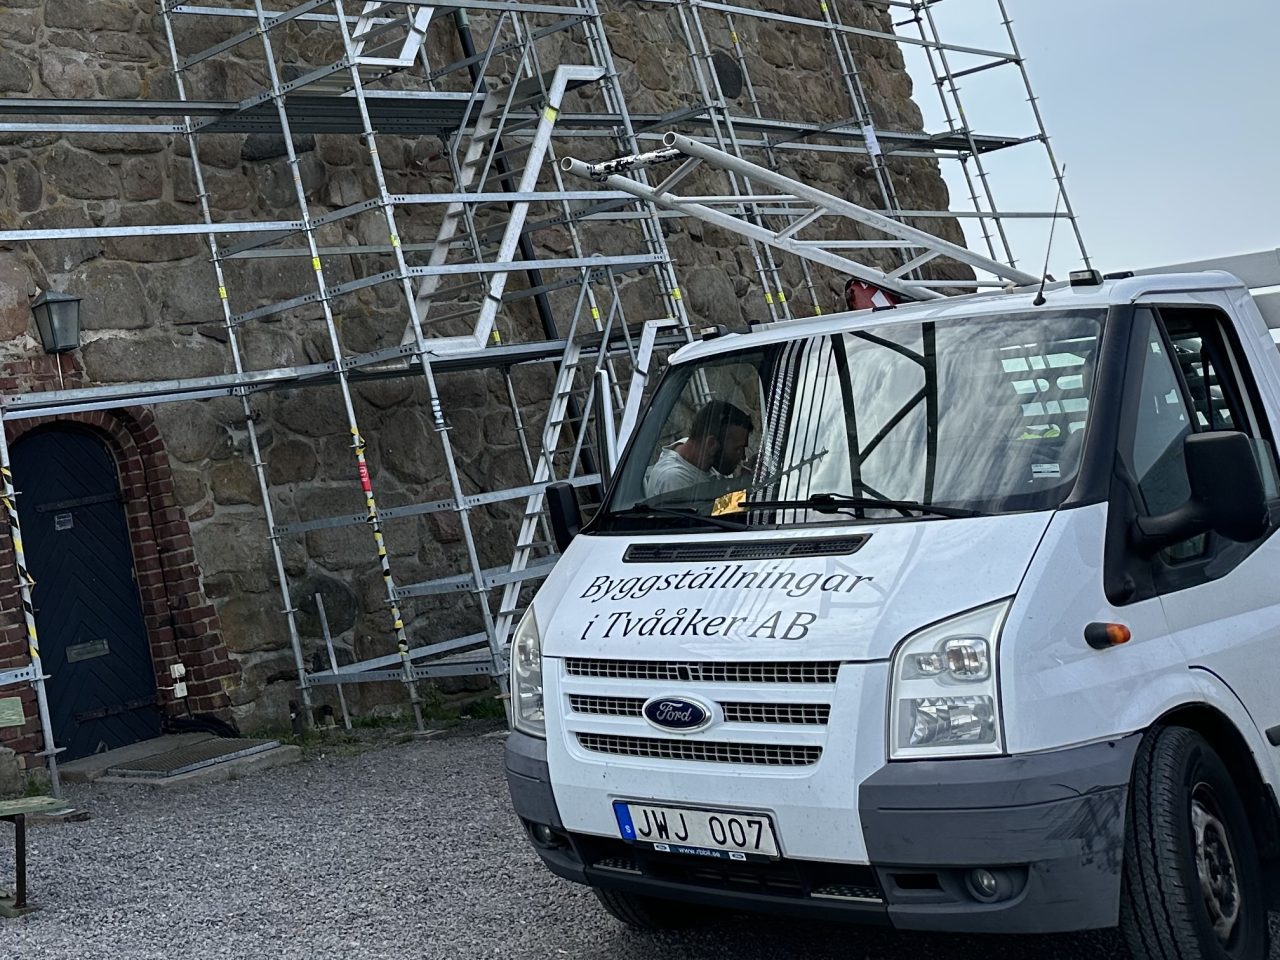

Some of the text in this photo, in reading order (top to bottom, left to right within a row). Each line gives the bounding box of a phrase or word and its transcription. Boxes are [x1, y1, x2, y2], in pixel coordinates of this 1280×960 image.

[579, 564, 874, 603] Byggställningar
[580, 607, 818, 641] i Tvååker AB
[655, 700, 692, 723] Ford
[624, 824, 631, 833] S
[638, 809, 763, 849] JWJ 007
